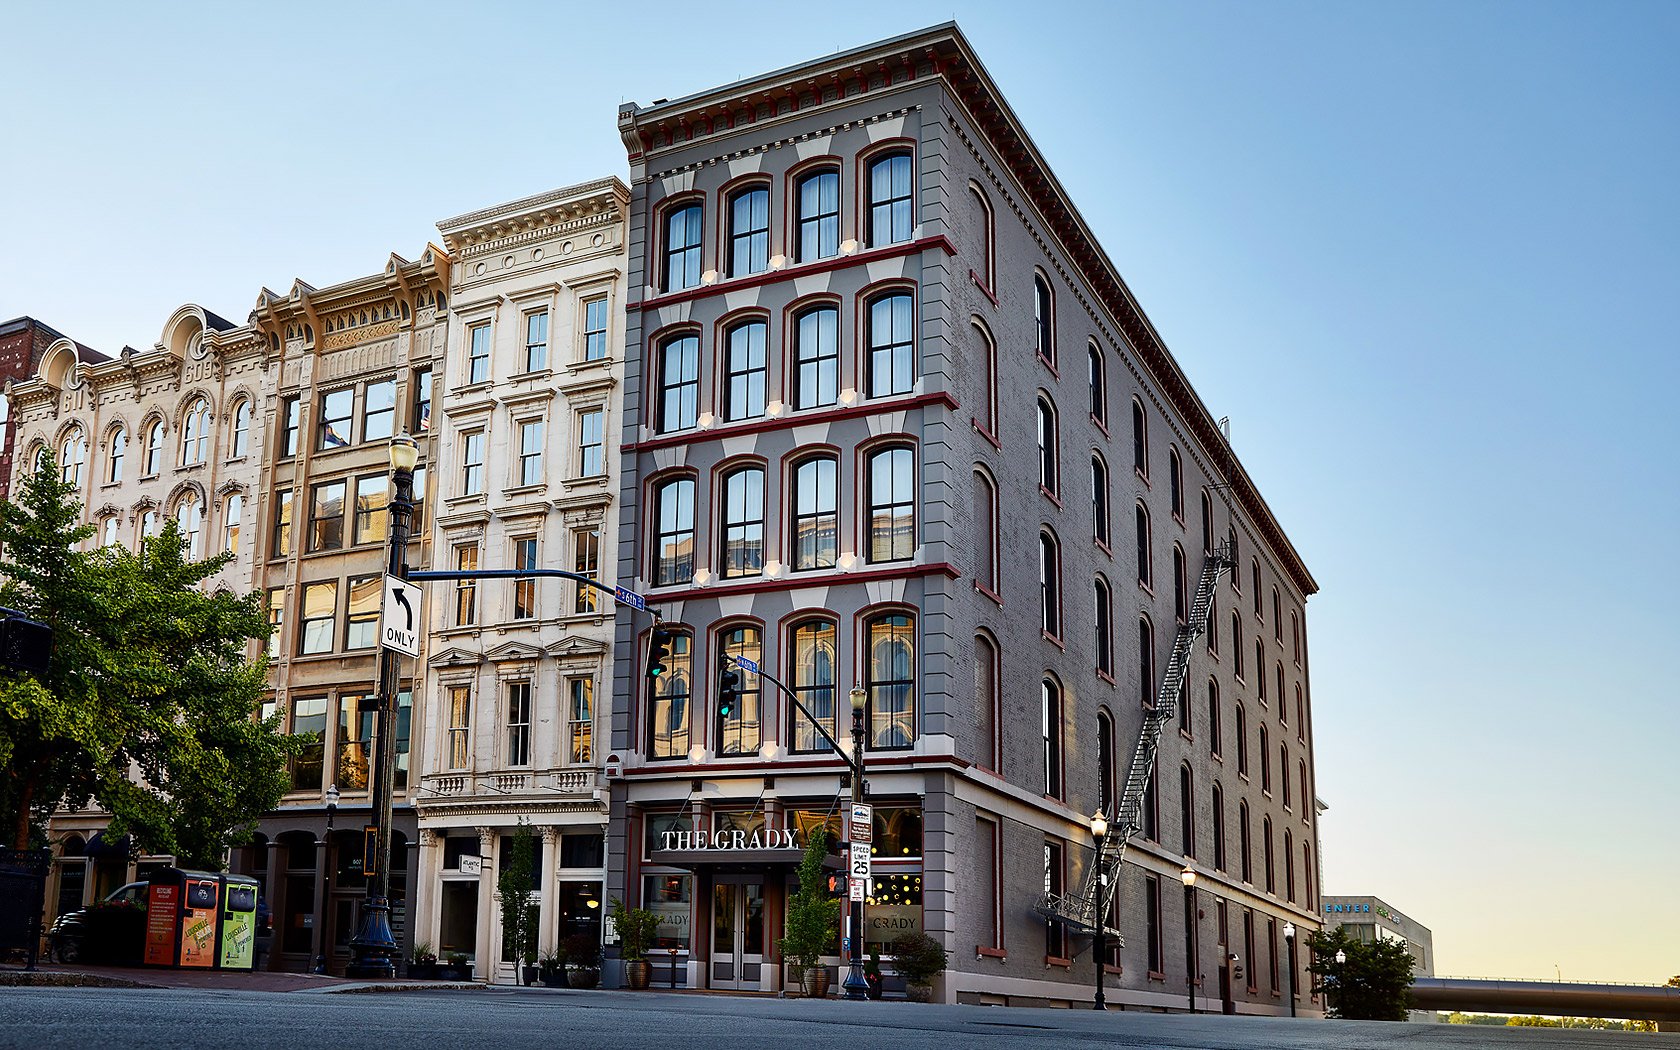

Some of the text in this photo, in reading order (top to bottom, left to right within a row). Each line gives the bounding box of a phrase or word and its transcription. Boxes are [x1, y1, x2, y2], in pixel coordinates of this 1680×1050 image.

[185, 361, 213, 384] 609
[64, 389, 84, 413] 611
[625, 592, 637, 606] 6th
[387, 627, 415, 649] ONLY
[661, 828, 799, 850] THE GRADY
[854, 861, 868, 875] 25
[1321, 903, 1370, 913] ENTER
[185, 919, 208, 938] LOUISVILLE
[225, 922, 248, 941] LOUISVILLE
[873, 917, 916, 929] GRADY
